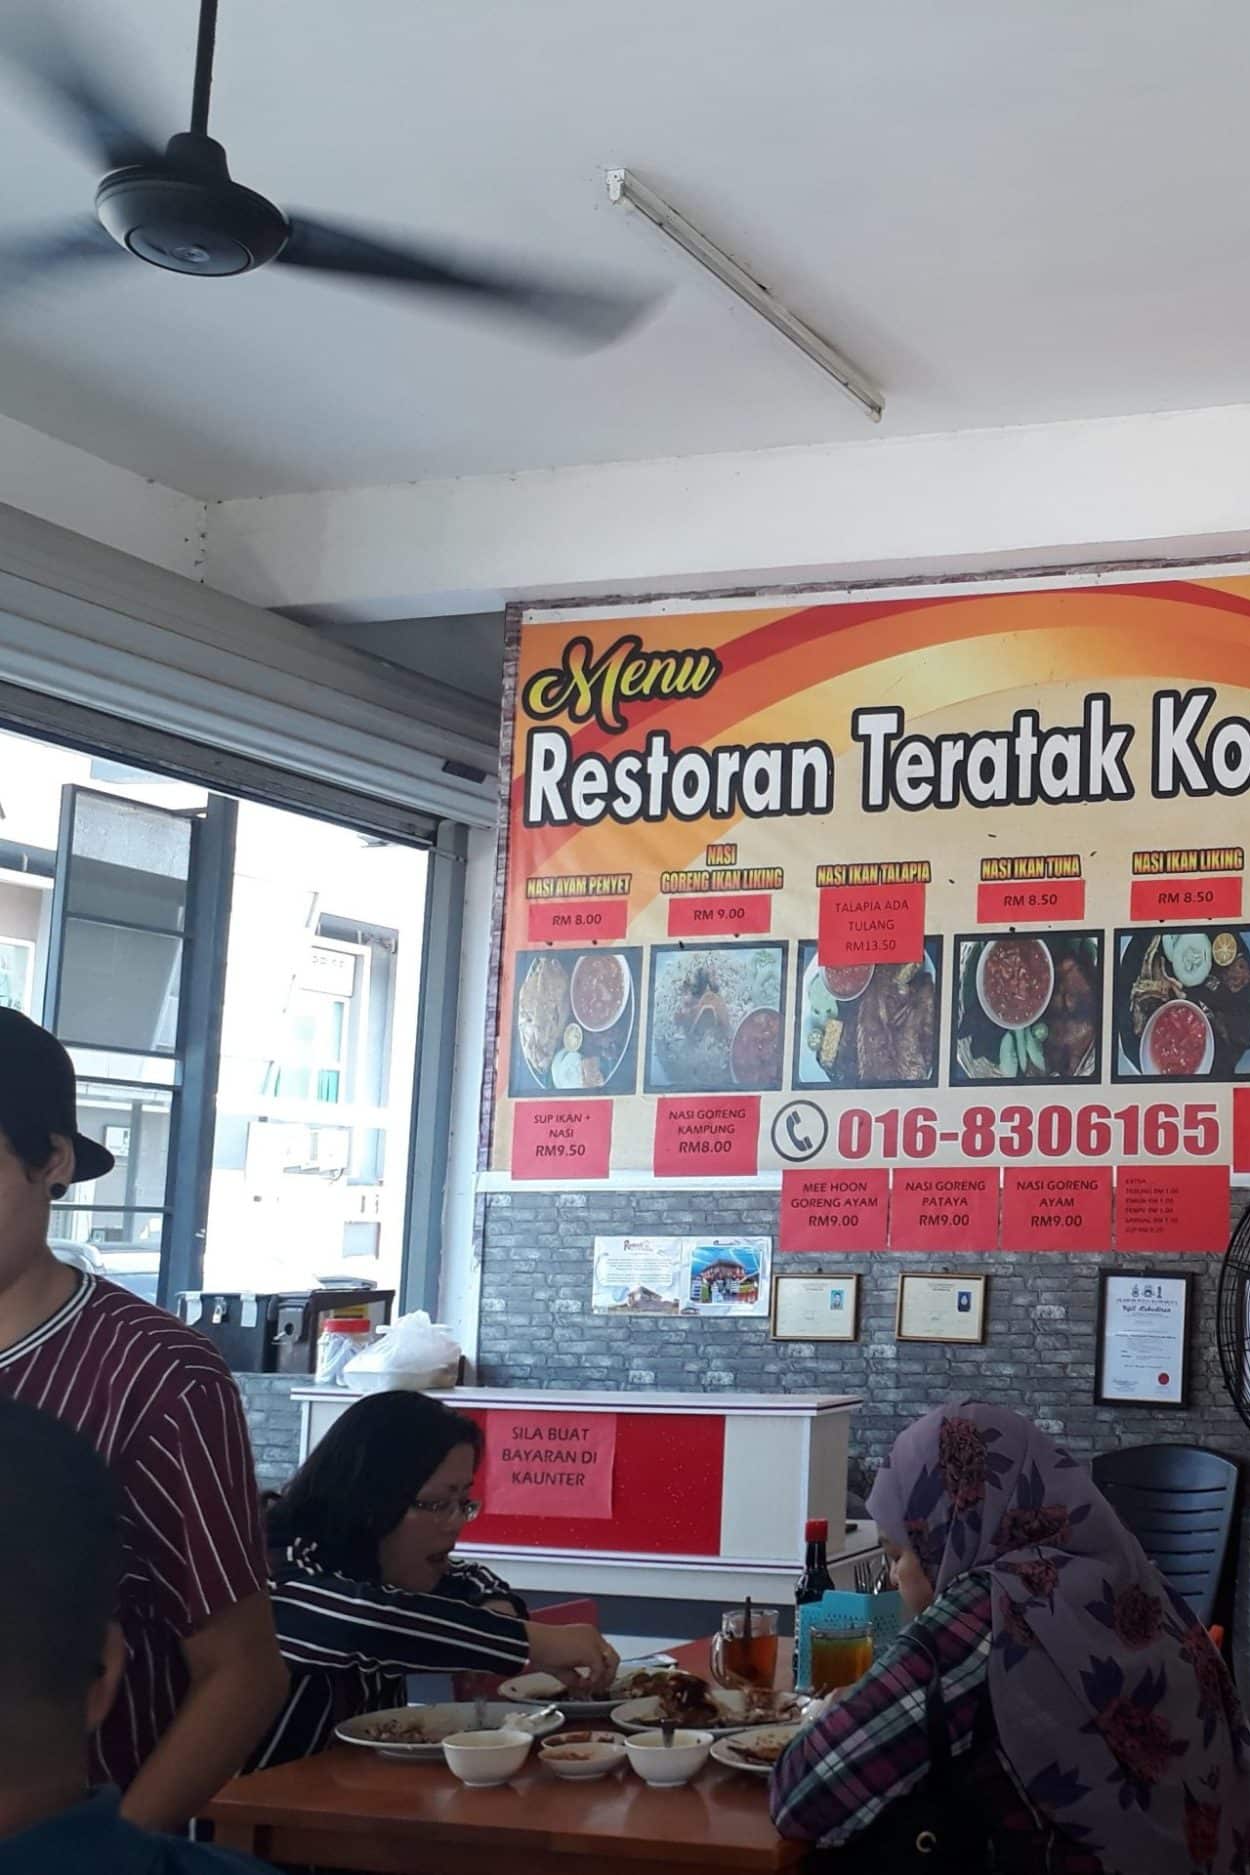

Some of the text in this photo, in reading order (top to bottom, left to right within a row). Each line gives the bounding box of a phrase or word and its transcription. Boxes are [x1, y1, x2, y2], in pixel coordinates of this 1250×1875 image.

[523, 634, 722, 733] Menu
[523, 726, 834, 828] Restoran
[852, 694, 1135, 812] Teratak
[706, 844, 737, 866] NASI
[1133, 847, 1244, 875] NASI IKAN LIKING
[817, 861, 931, 886] NASI IKAN TALAPIA
[981, 855, 1082, 880] NASI IKAN TUNA
[527, 873, 632, 898] NASI AYAM PENYET
[661, 868, 784, 893] GORENG IKAN LIKING
[1003, 893, 1058, 907] RM 8.50
[1158, 890, 1214, 904] RM 8.50
[834, 900, 910, 914] TALAPIA ADA
[552, 913, 602, 926] RM 8.00
[694, 908, 745, 922] RM 9.00
[848, 920, 896, 932] TULANG
[845, 939, 897, 952] RM13.50
[533, 1114, 554, 1124] SUP
[555, 1113, 583, 1123] IKAN
[669, 1108, 746, 1120] NASI GORENG
[548, 1129, 574, 1138] NASI
[677, 1124, 736, 1135] KAMPUNG
[837, 1103, 1221, 1160] 016-8306165
[535, 1143, 586, 1157] RM9.50
[678, 1140, 732, 1153] RM8.00
[802, 1182, 868, 1193] MEE HOON
[905, 1180, 986, 1191] NASI GORENG
[1016, 1180, 1099, 1191] NASI GORENG
[790, 1197, 879, 1208] GORENG AYAM
[921, 1196, 969, 1207] PATAYA
[1039, 1197, 1075, 1208] AYAM
[808, 1215, 859, 1227] RM9.00
[918, 1214, 970, 1227] RM9.00
[1030, 1215, 1083, 1228] RM9.00
[511, 1426, 590, 1442] SILA BUAT
[502, 1448, 597, 1465] BAYARAN DI
[511, 1471, 585, 1487] KAUNTER
